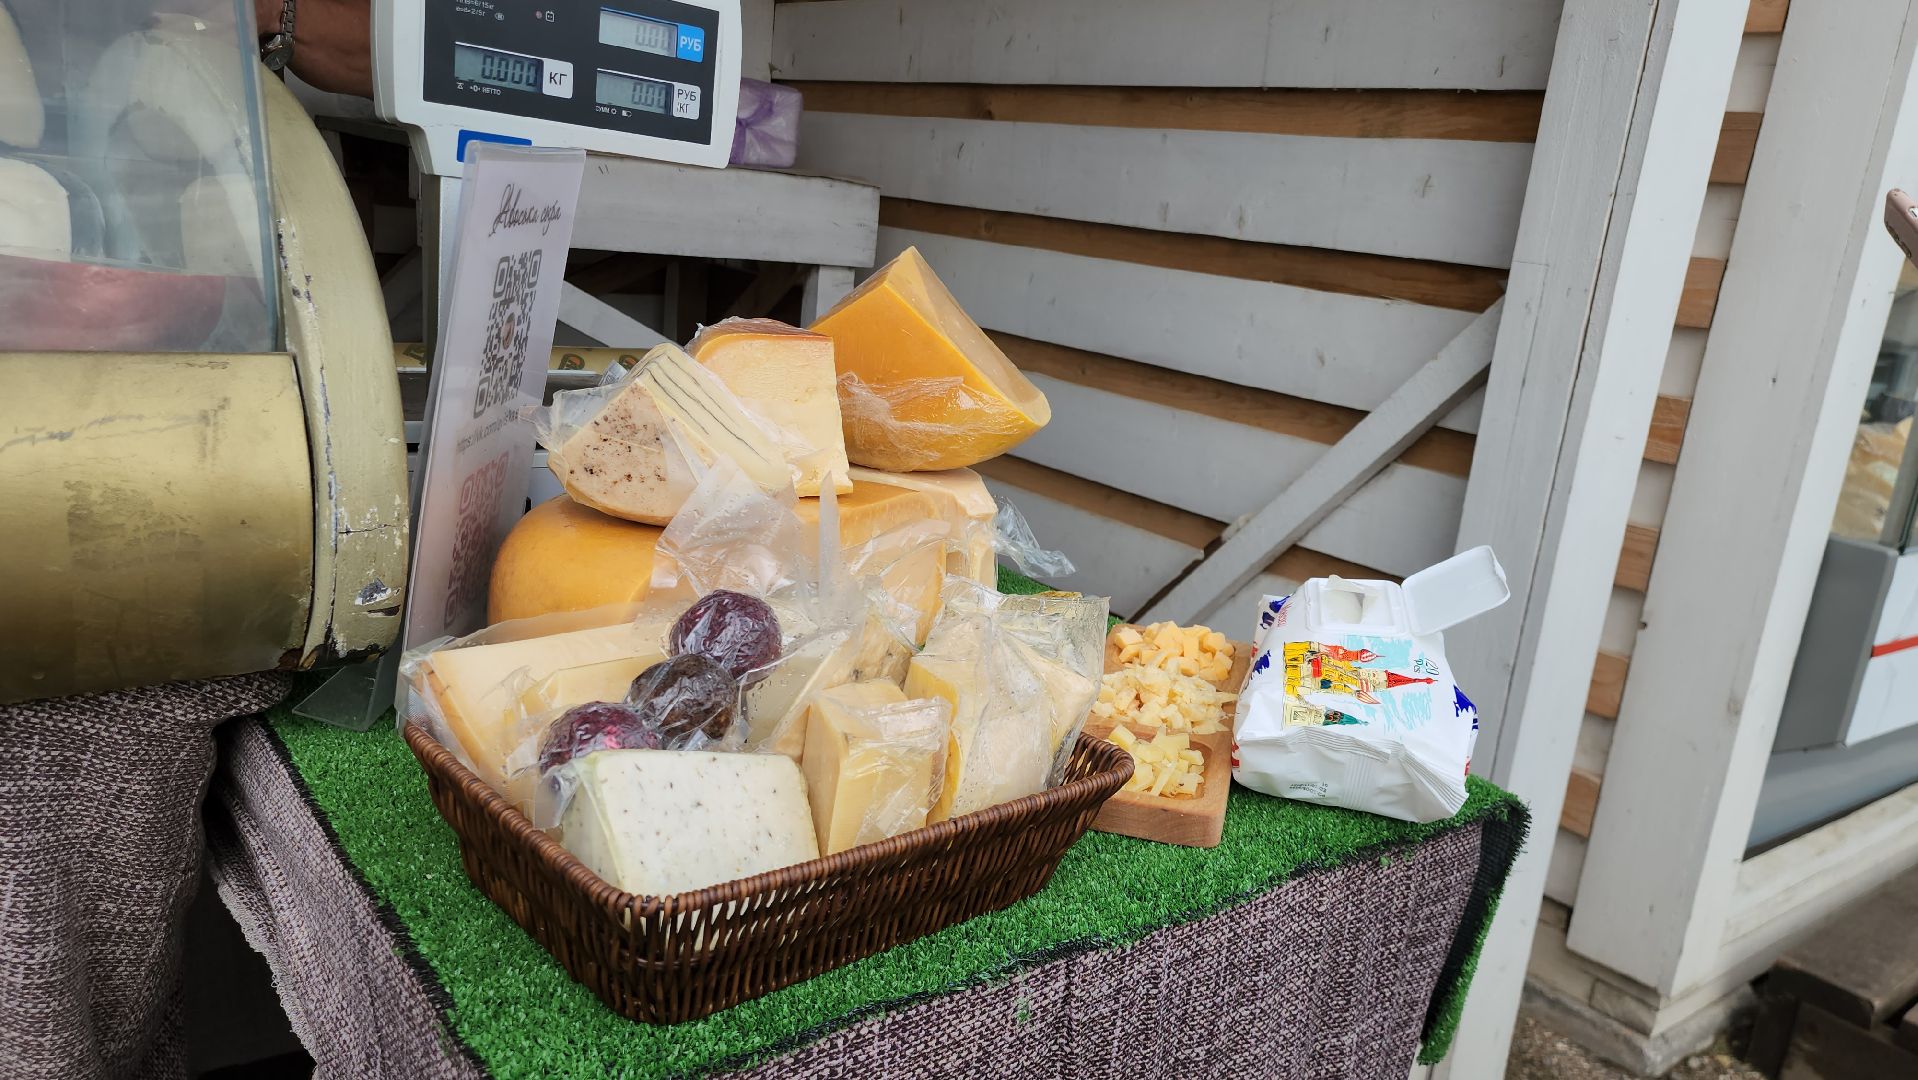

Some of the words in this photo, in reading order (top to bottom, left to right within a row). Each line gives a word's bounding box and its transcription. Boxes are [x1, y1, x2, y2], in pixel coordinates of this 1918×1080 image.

[680, 35, 702, 52] РУБ
[481, 55, 536, 87] 0.000
[549, 71, 568, 86] КГ
[677, 88, 697, 101] РУБ
